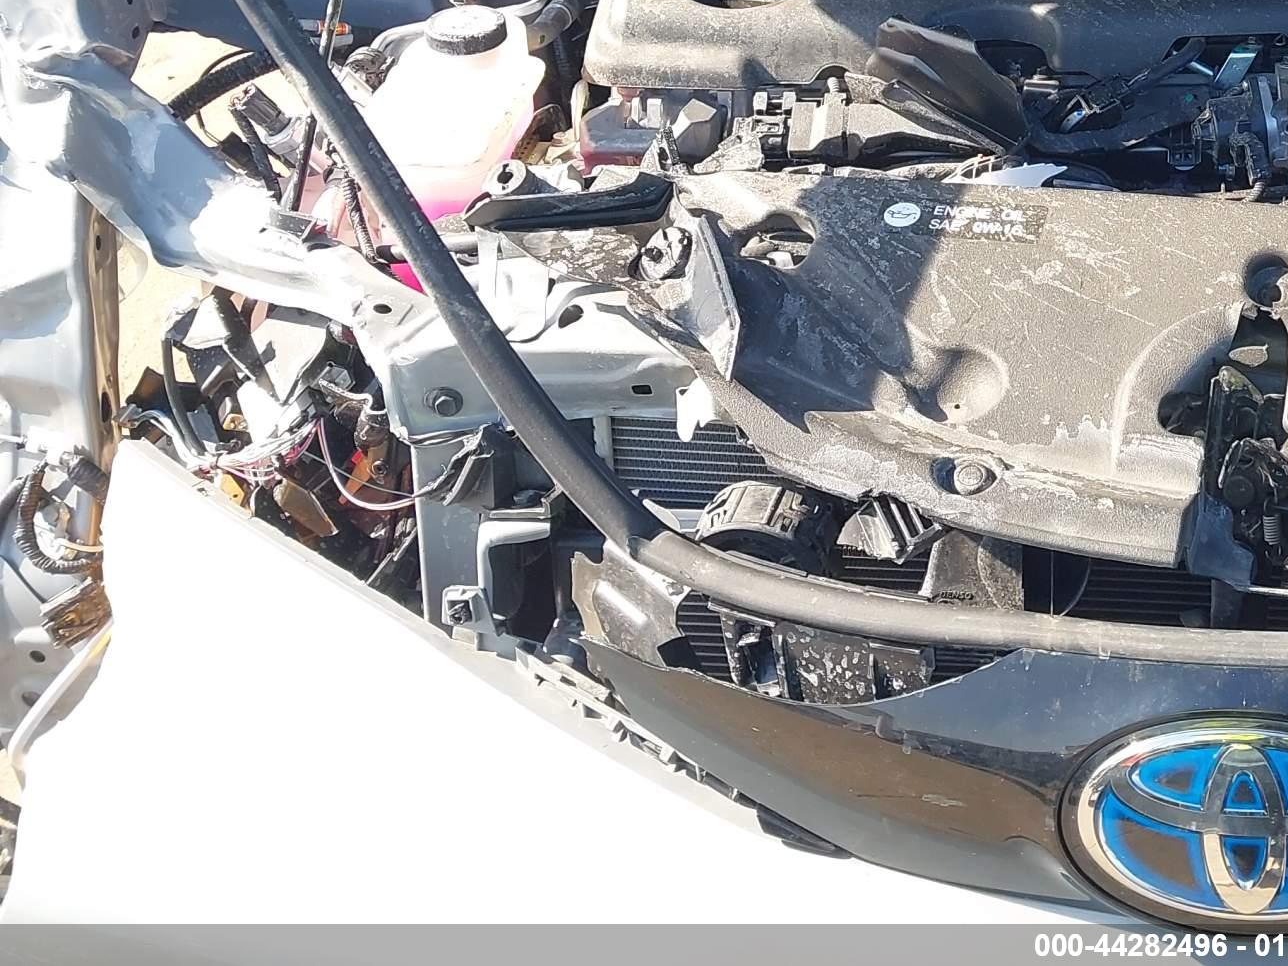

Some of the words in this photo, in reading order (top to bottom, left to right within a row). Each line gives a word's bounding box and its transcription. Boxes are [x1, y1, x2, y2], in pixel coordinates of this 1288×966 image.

[933, 205, 993, 220] ENGINE
[1000, 209, 1026, 222] OIL
[928, 218, 962, 232] SAE
